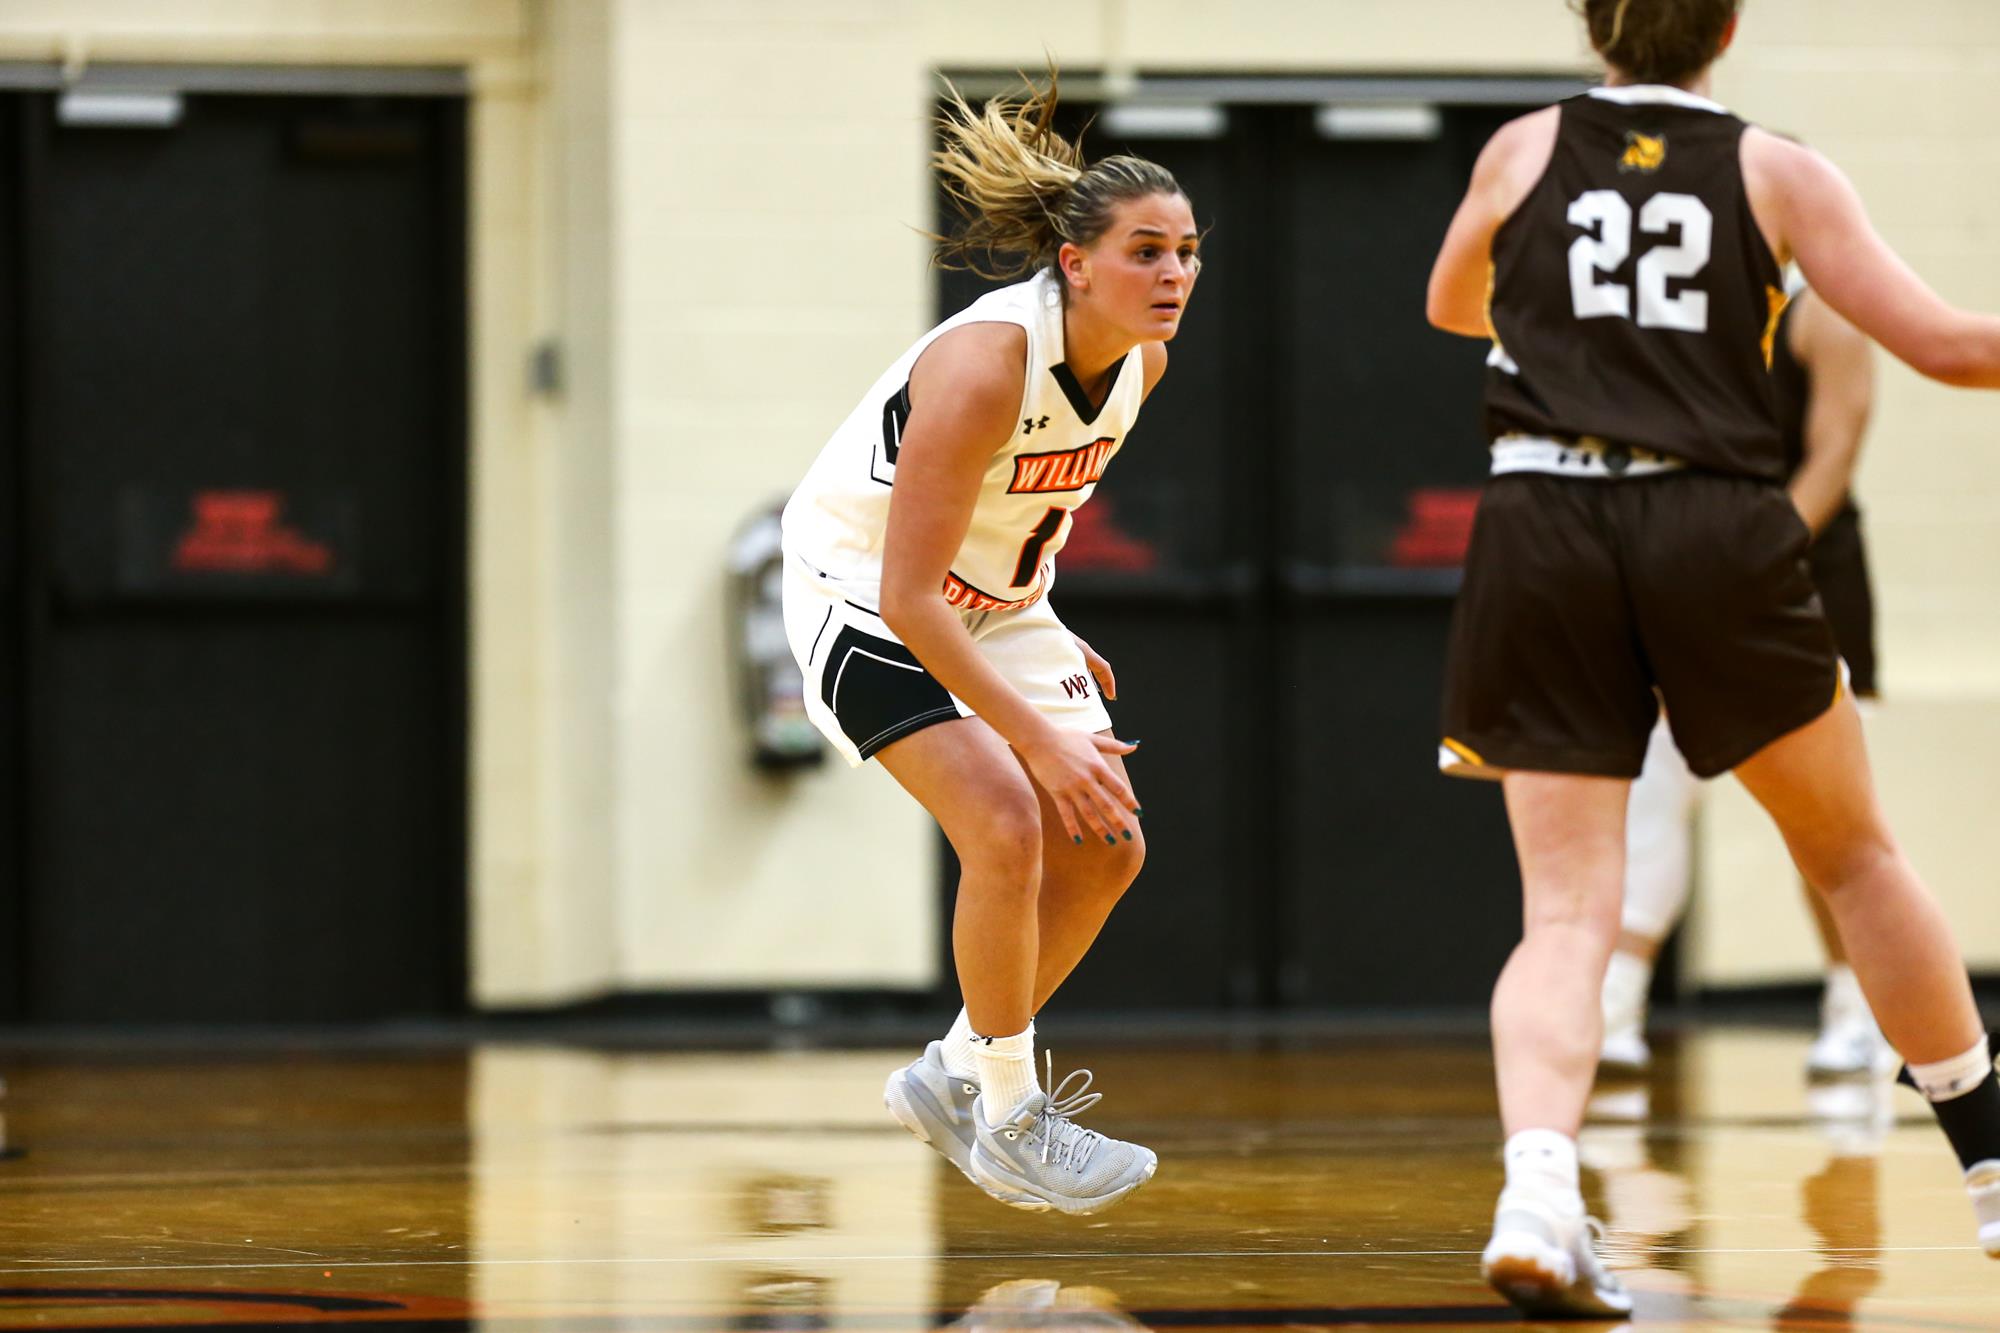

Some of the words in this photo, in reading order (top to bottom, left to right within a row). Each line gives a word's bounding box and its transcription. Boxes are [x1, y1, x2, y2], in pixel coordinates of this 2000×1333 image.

[1567, 189, 1712, 332] 22
[1008, 505, 1067, 588] 1
[1060, 673, 1090, 699] WP
